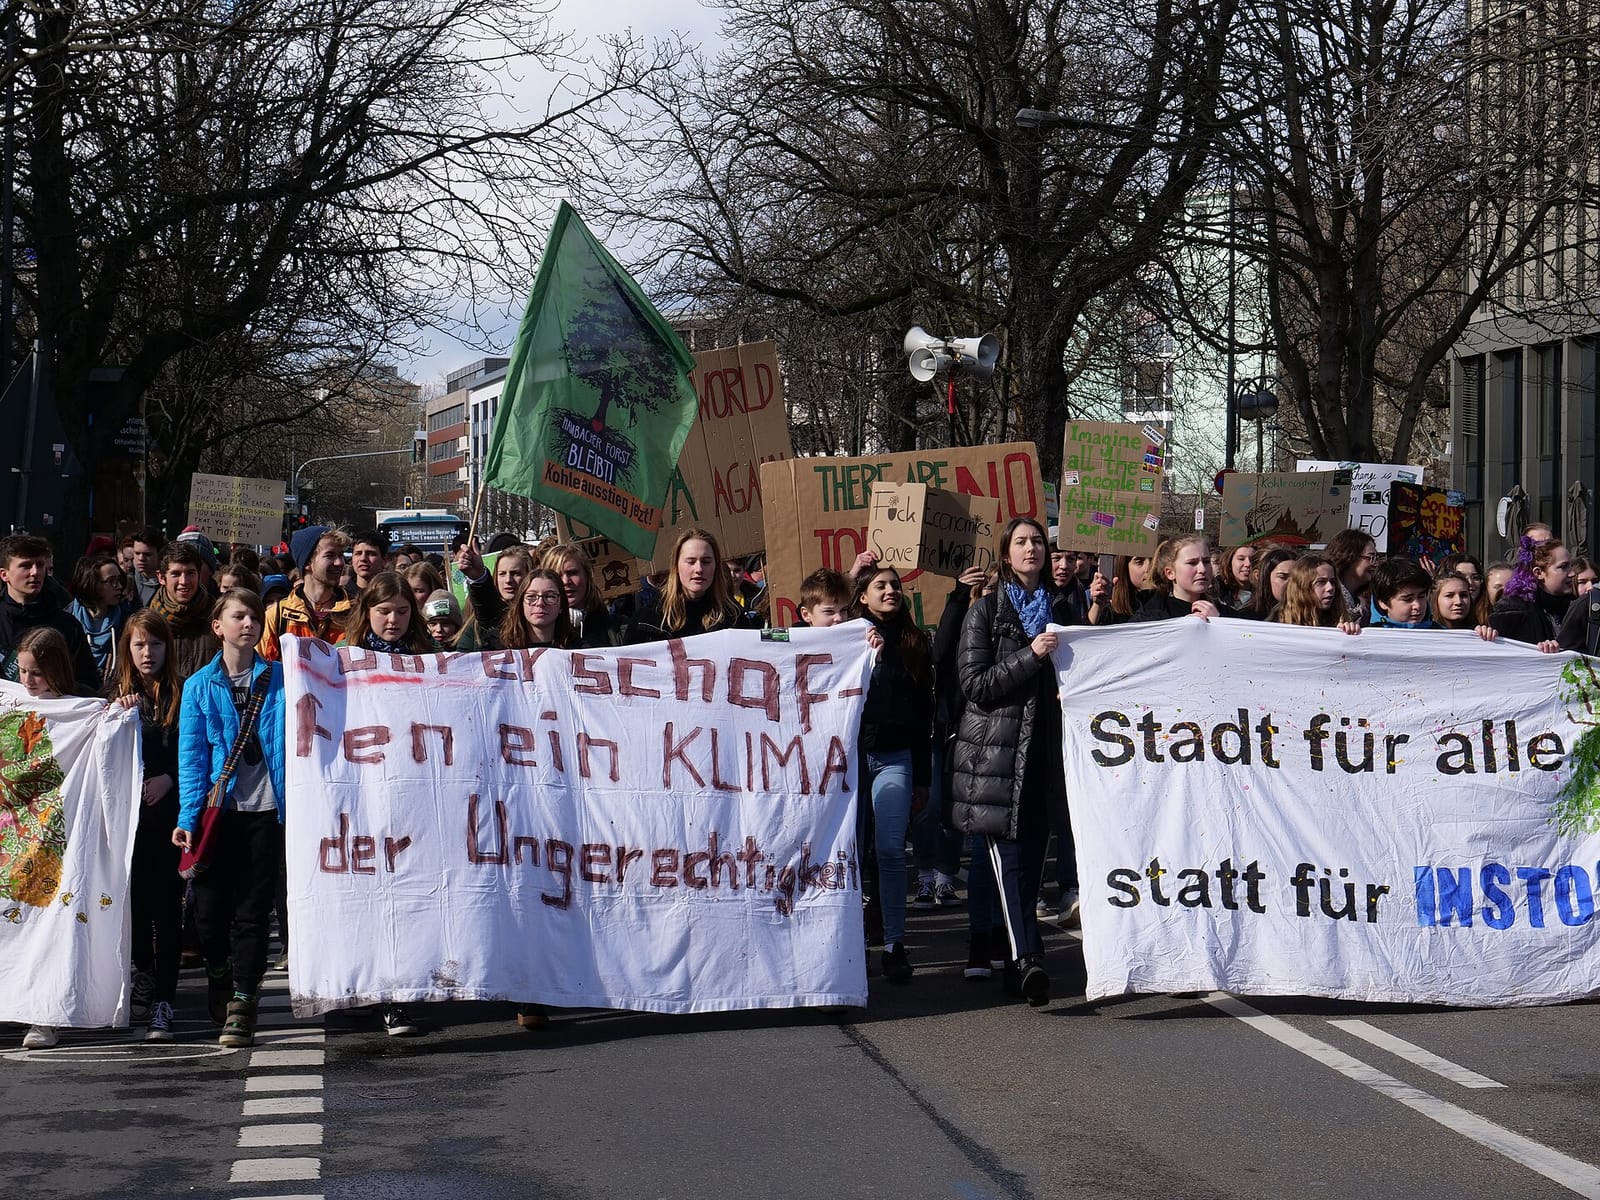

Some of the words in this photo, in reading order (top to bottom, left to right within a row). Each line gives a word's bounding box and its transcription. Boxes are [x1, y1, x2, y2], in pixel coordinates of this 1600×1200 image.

[689, 363, 773, 422] WORLD
[605, 442, 631, 465] FORST
[1070, 424, 1142, 456] Imagine
[567, 443, 614, 485] BLEIBT!
[1067, 445, 1096, 472] all
[1105, 448, 1139, 477] the
[217, 480, 229, 488] THE
[231, 482, 250, 490] LAST
[255, 484, 272, 492] TREE
[545, 462, 629, 514] Kohleausstieg
[714, 452, 784, 517] AGA
[955, 452, 1037, 523] NO
[1081, 464, 1136, 498] people
[232, 520, 257, 529] CANNOT
[1066, 488, 1127, 522] fighting
[1130, 496, 1153, 520] for
[388, 530, 400, 542] 36
[871, 528, 913, 563] Save
[916, 532, 936, 567] the
[1076, 523, 1099, 537] our
[1106, 521, 1148, 544] earth
[499, 711, 620, 782] ein
[663, 722, 850, 796] KLIMA
[1089, 708, 1280, 769] Stadt
[1303, 713, 1410, 774] für
[1436, 719, 1566, 775] alle
[320, 812, 413, 876] der
[466, 793, 860, 917] Ungerechtigkeit
[1106, 857, 1266, 914] statt
[1290, 863, 1391, 924] für
[1413, 862, 1600, 931] INSTO
